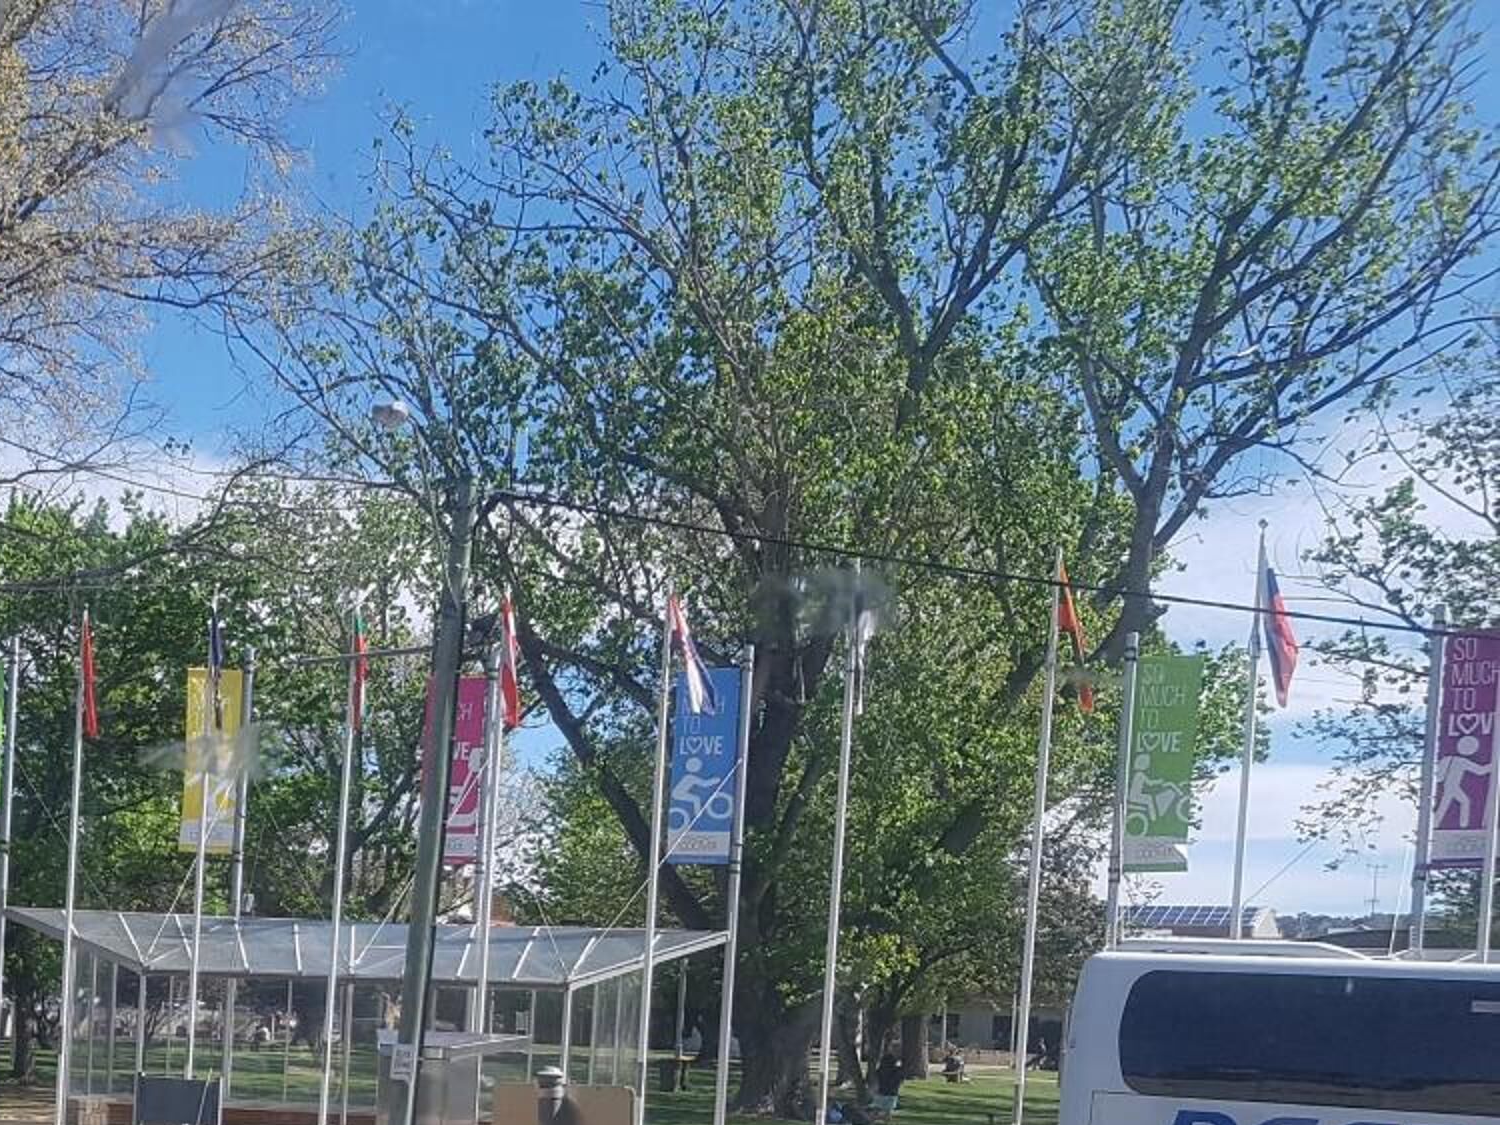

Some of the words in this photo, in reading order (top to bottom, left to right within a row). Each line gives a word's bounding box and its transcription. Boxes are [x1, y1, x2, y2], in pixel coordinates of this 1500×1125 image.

[1454, 637, 1477, 661] SO
[1142, 663, 1164, 684] SO
[1140, 684, 1186, 707] MUCH
[1452, 687, 1476, 711] TO
[682, 715, 701, 735] TO
[1140, 707, 1159, 730] TO
[679, 735, 724, 755] LOVE
[1136, 731, 1183, 753] LOVE
